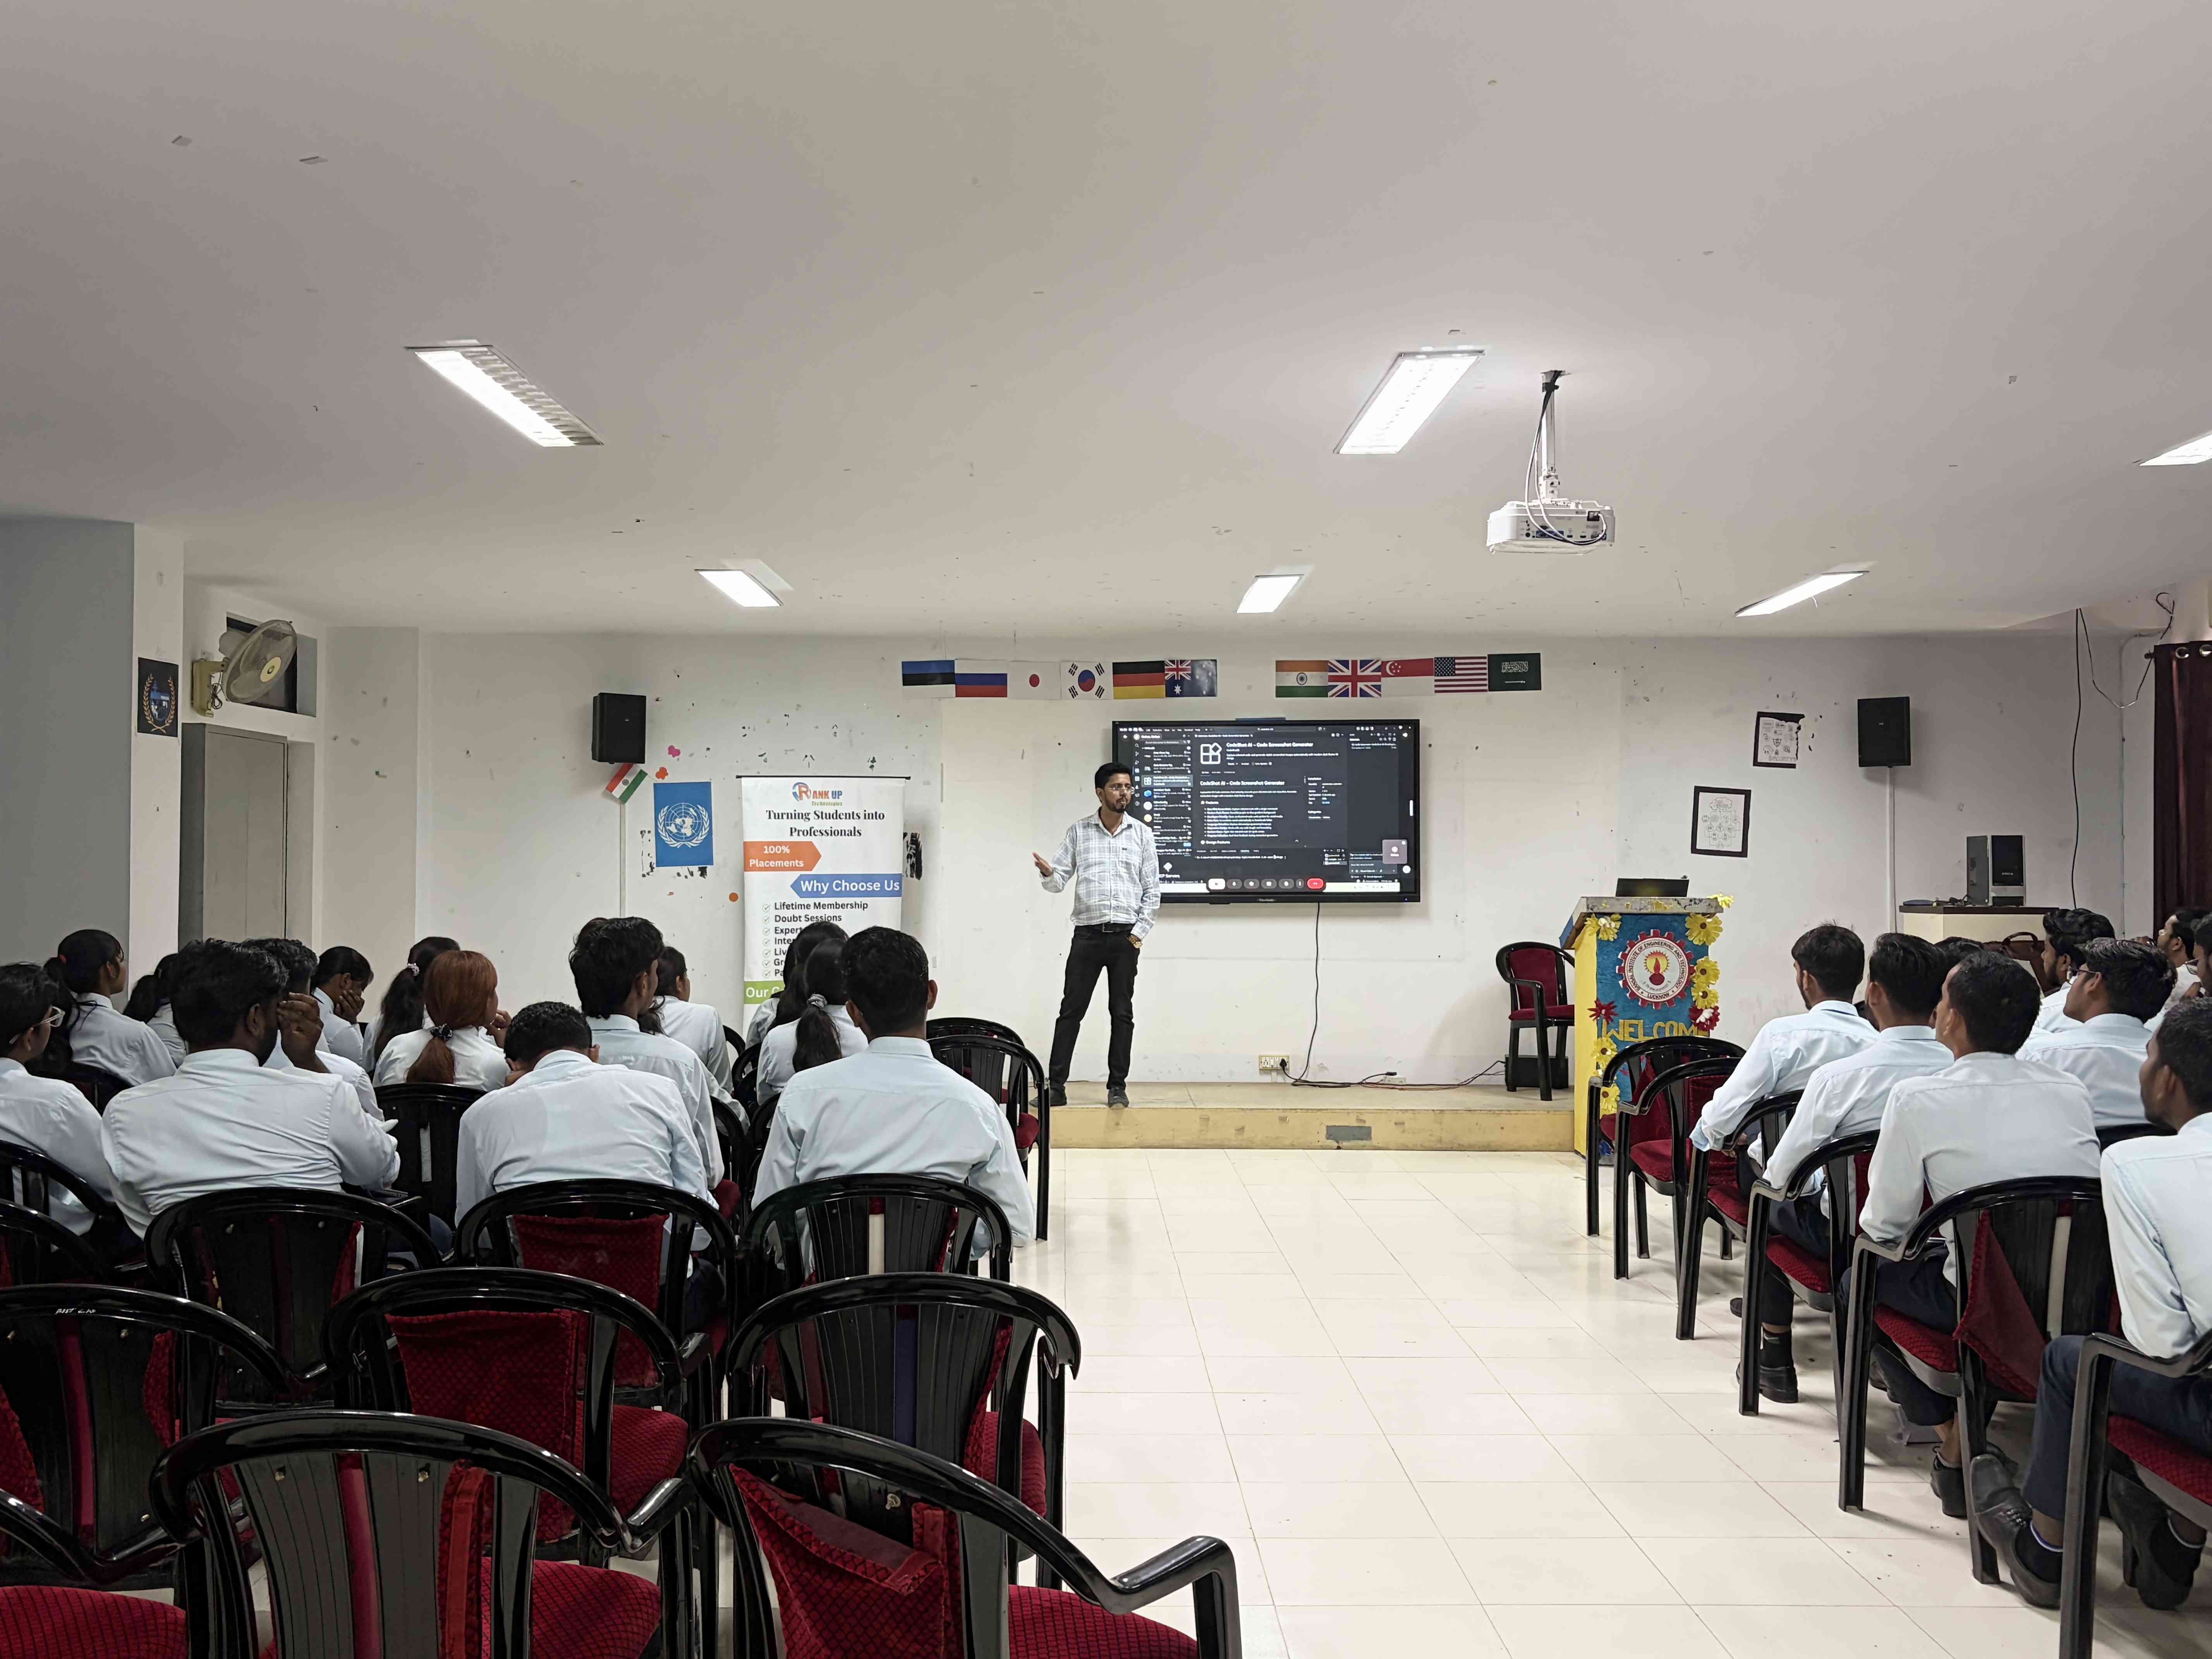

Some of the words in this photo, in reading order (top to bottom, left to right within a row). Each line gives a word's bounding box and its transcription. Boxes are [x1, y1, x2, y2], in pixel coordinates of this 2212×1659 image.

[831, 790, 843, 799] UP
[766, 809, 811, 822] Turning
[814, 809, 861, 820] Students
[863, 810, 885, 820] into
[789, 826, 862, 837] Professionals
[763, 845, 790, 854] 100%
[749, 859, 804, 867] Placements
[800, 880, 829, 895] Why
[832, 879, 881, 891] Choose
[884, 879, 900, 891] Us
[775, 902, 811, 910] Lifetime
[813, 901, 868, 911] Membership
[775, 914, 802, 922] Doubt
[804, 914, 842, 922] Sessions
[1644, 941, 1674, 951] ENGINEERING
[1628, 952, 1638, 973] INSTITUTE
[1675, 959, 1685, 988] TECHNOLOGY
[1629, 974, 1640, 991] BANSAL
[746, 986, 769, 998] Our
[1602, 1019, 1709, 1042] WELCOM
